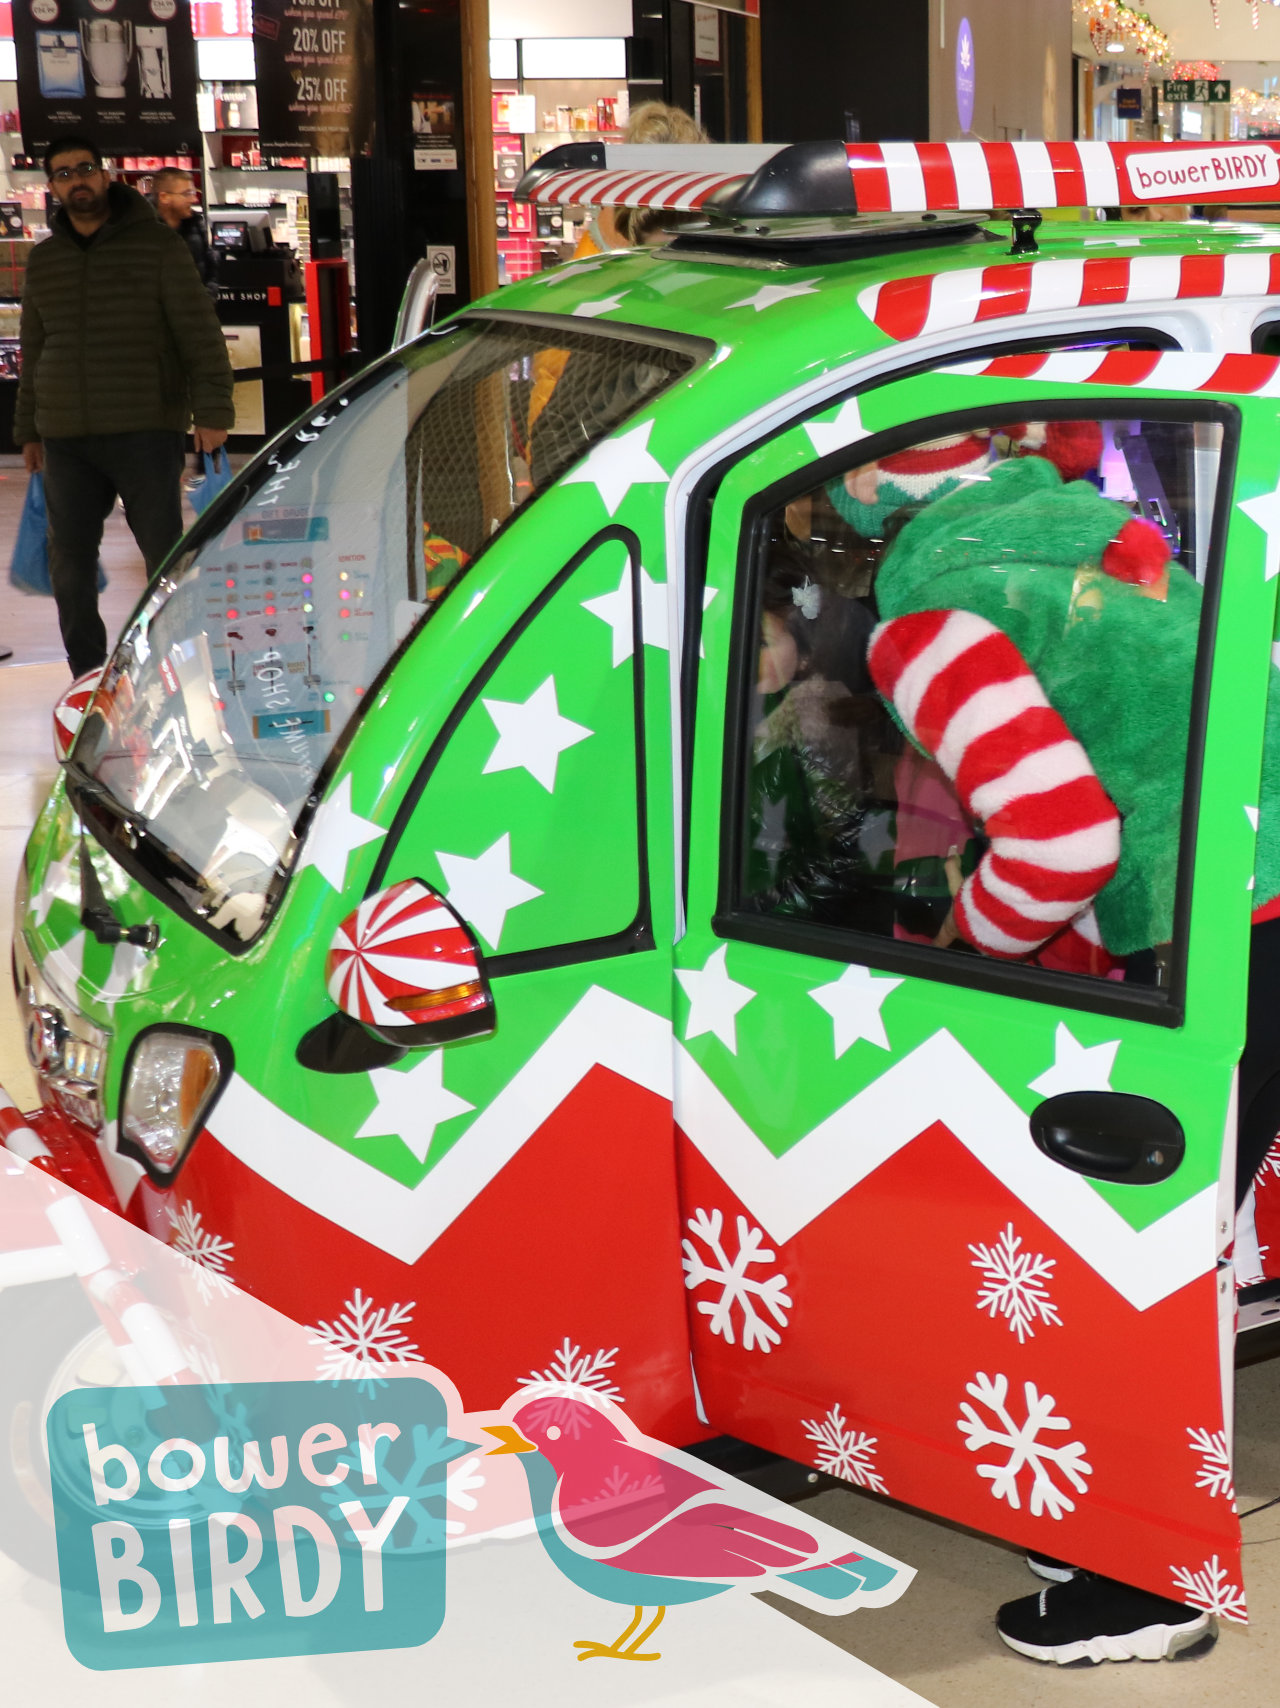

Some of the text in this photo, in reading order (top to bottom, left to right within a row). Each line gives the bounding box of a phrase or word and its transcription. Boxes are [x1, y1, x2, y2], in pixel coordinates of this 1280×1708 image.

[293, 27, 319, 53] 20%
[321, 29, 346, 54] OFF
[296, 77, 348, 102] 25% OFF
[1166, 82, 1188, 91] Fire
[1166, 92, 1188, 101] exit
[1135, 153, 1267, 190] bowerBIRDY
[241, 289, 267, 301] SHOP
